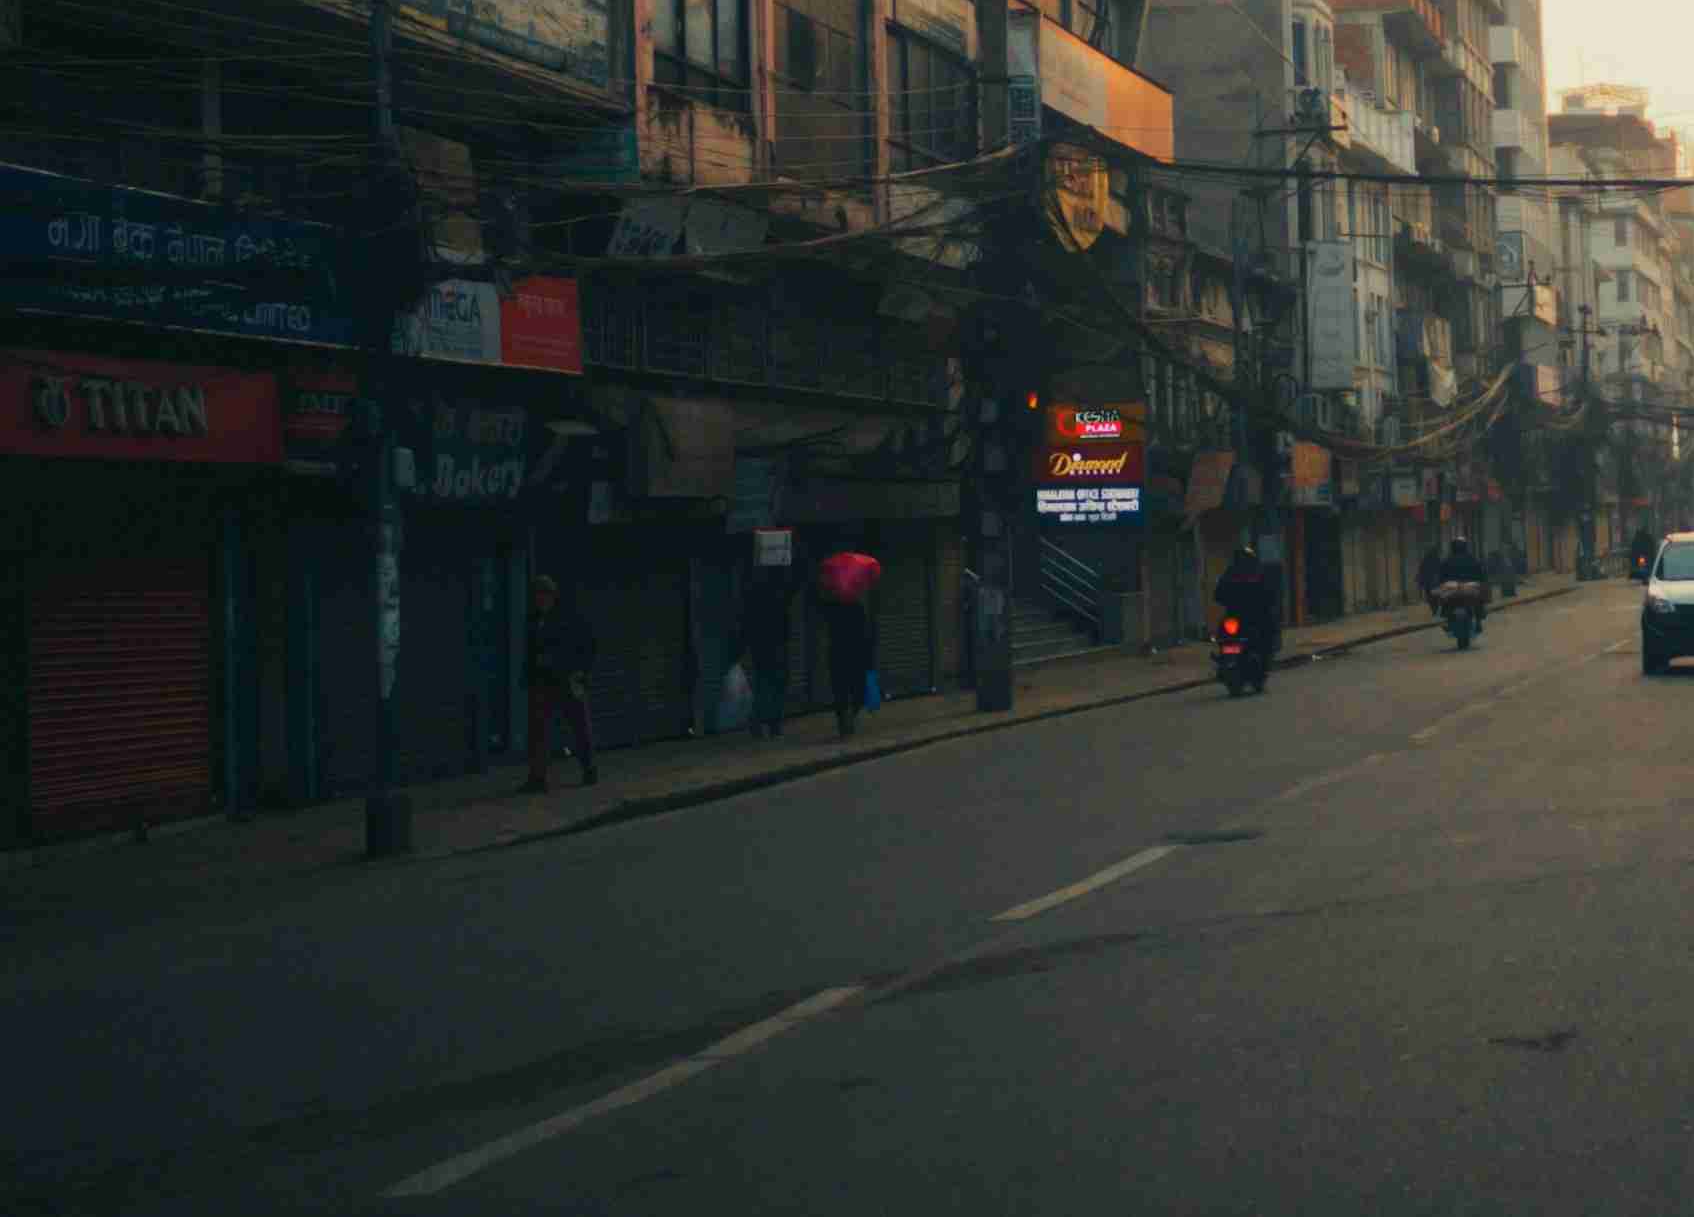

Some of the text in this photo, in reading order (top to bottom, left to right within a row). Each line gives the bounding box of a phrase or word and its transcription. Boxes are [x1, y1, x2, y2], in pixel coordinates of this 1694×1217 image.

[79, 378, 208, 433] TITAN
[433, 453, 523, 499] Bakery
[1049, 451, 1128, 476] Diamond
